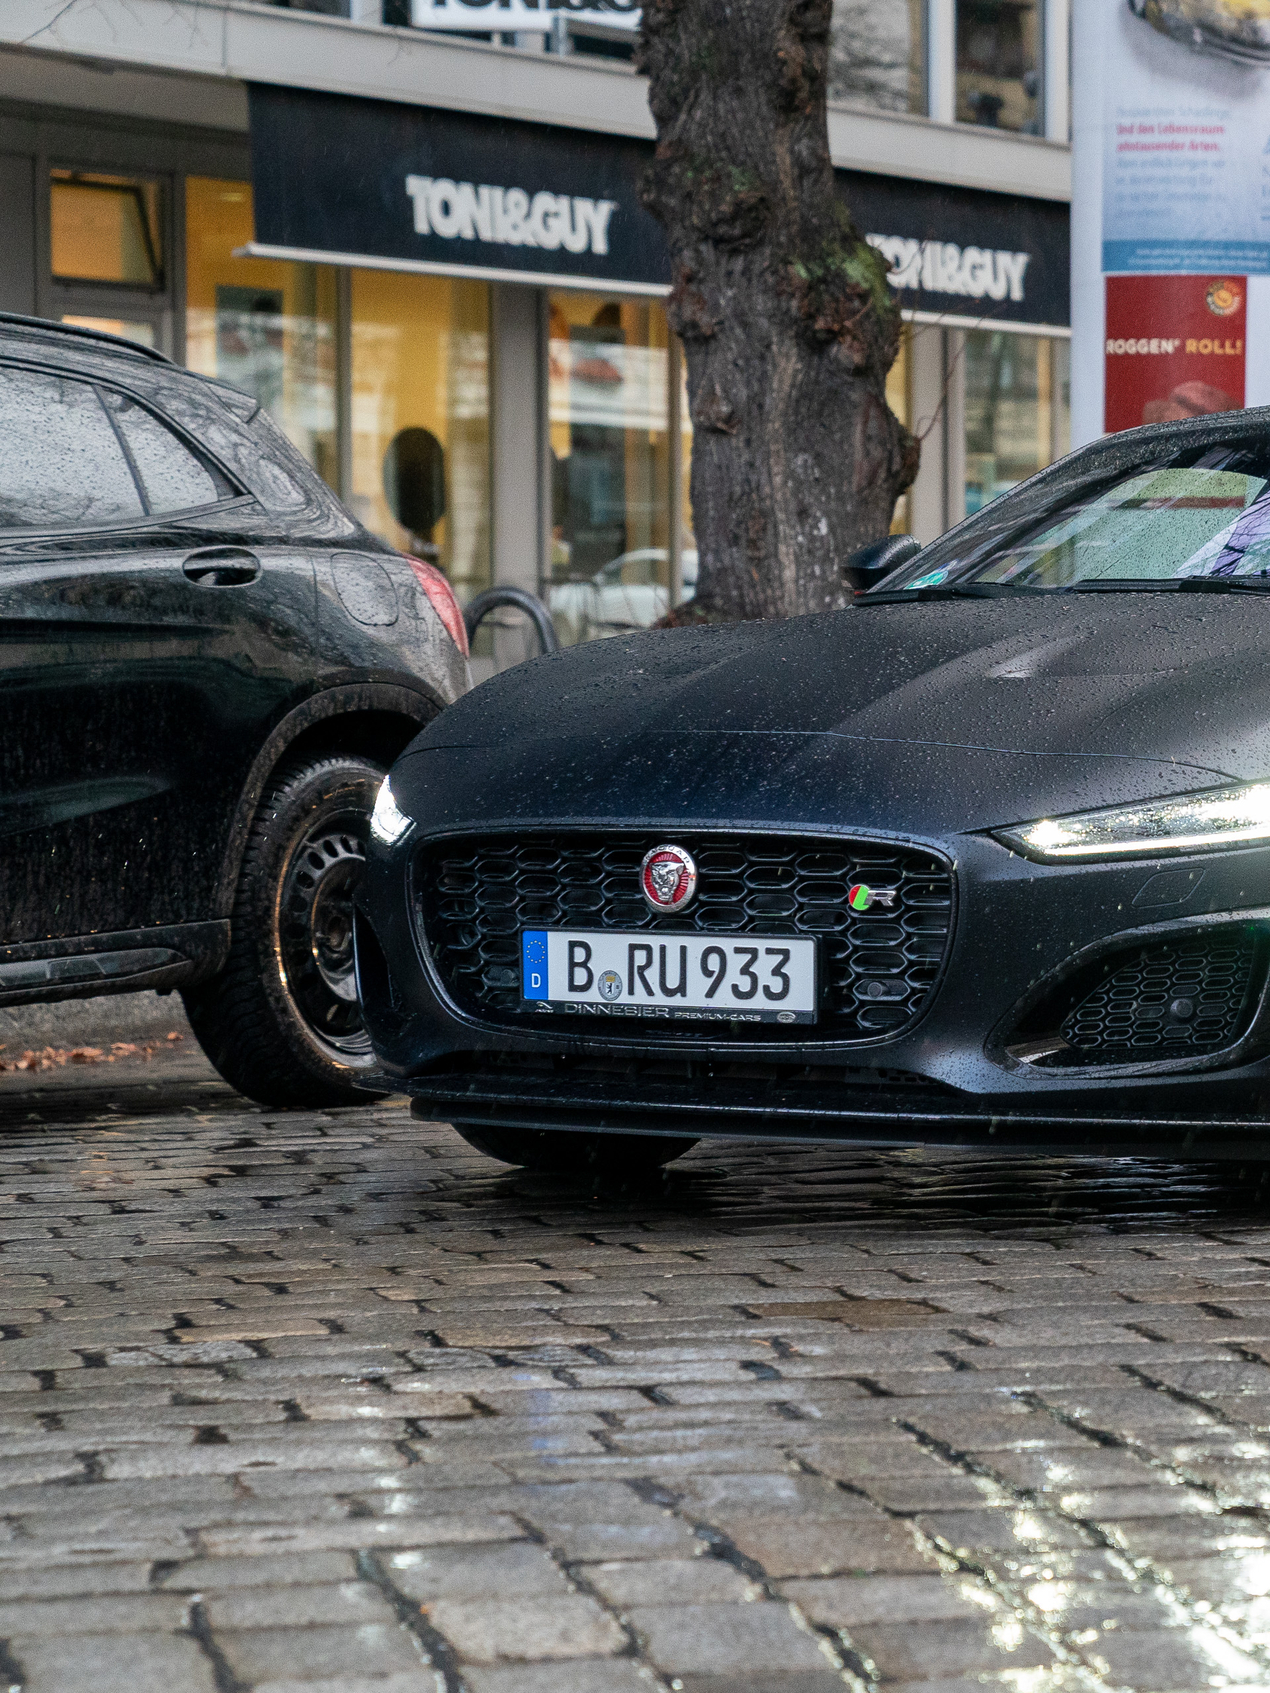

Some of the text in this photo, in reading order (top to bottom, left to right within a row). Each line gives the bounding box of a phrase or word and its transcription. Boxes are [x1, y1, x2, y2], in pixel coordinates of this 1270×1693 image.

[406, 174, 614, 255] TONI&GUY
[1185, 338, 1243, 355] ROLL!
[567, 939, 595, 993] B
[628, 943, 688, 998] RU
[700, 946, 791, 1001] 933
[531, 973, 541, 988] D
[564, 1003, 669, 1018] DINNEBIER
